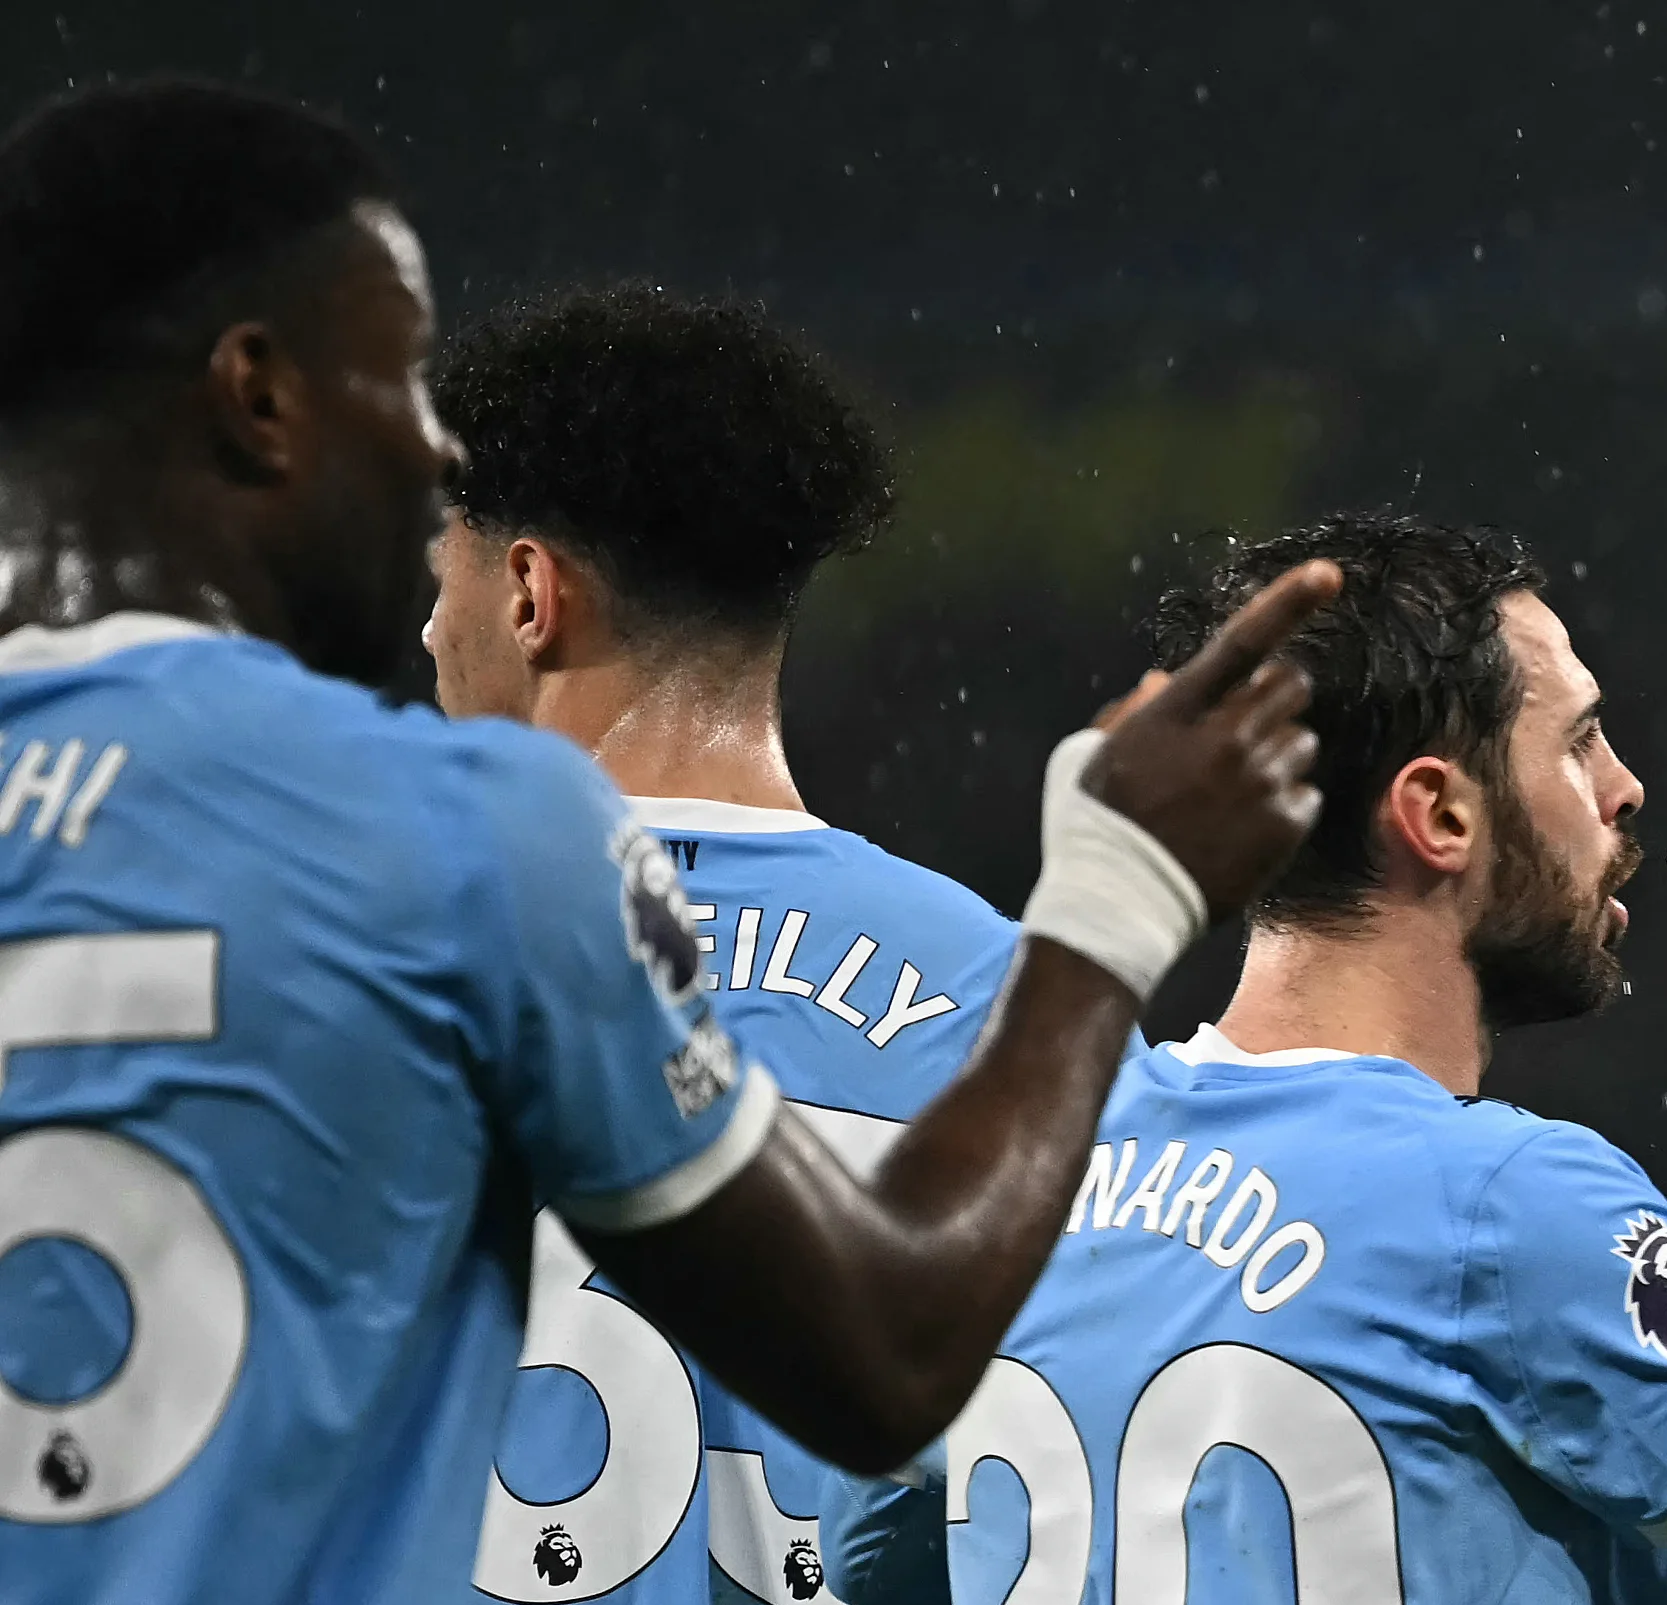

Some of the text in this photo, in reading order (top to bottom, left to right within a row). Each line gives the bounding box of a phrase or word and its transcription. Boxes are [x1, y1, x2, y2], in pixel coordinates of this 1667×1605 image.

[0, 730, 128, 848] HI
[659, 839, 699, 871] TY
[0, 928, 249, 1525] 5
[1064, 1136, 1326, 1314] NARDO
